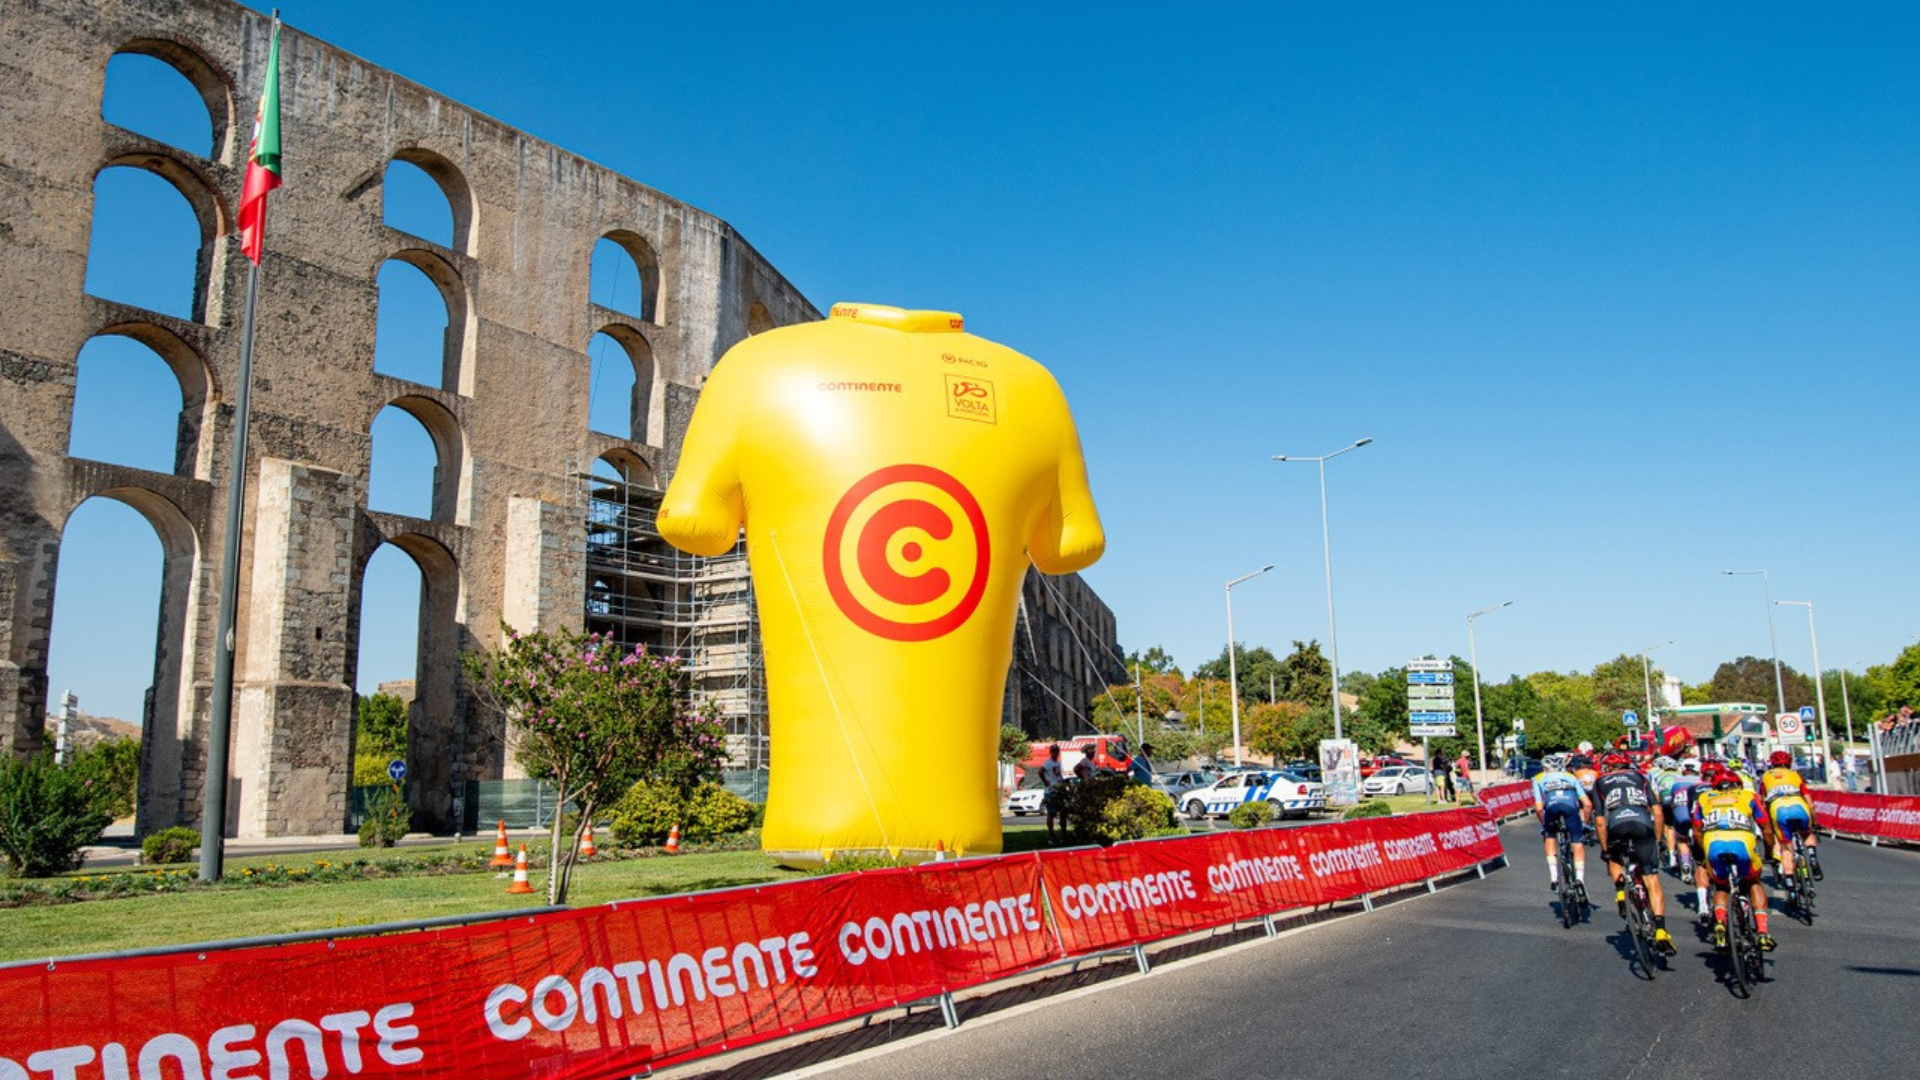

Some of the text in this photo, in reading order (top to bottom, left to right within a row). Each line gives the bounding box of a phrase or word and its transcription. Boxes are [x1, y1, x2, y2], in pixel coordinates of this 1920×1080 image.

[817, 381, 902, 393] CONTINENTE
[954, 397, 990, 412] VOLTA
[1061, 870, 1197, 920] CONTINENTE
[1207, 854, 1304, 894] CONTINENTE
[1309, 842, 1383, 877] CONTINENTE
[484, 932, 818, 1041] CONTINENTE
[839, 894, 1039, 965] CONTINENTE
